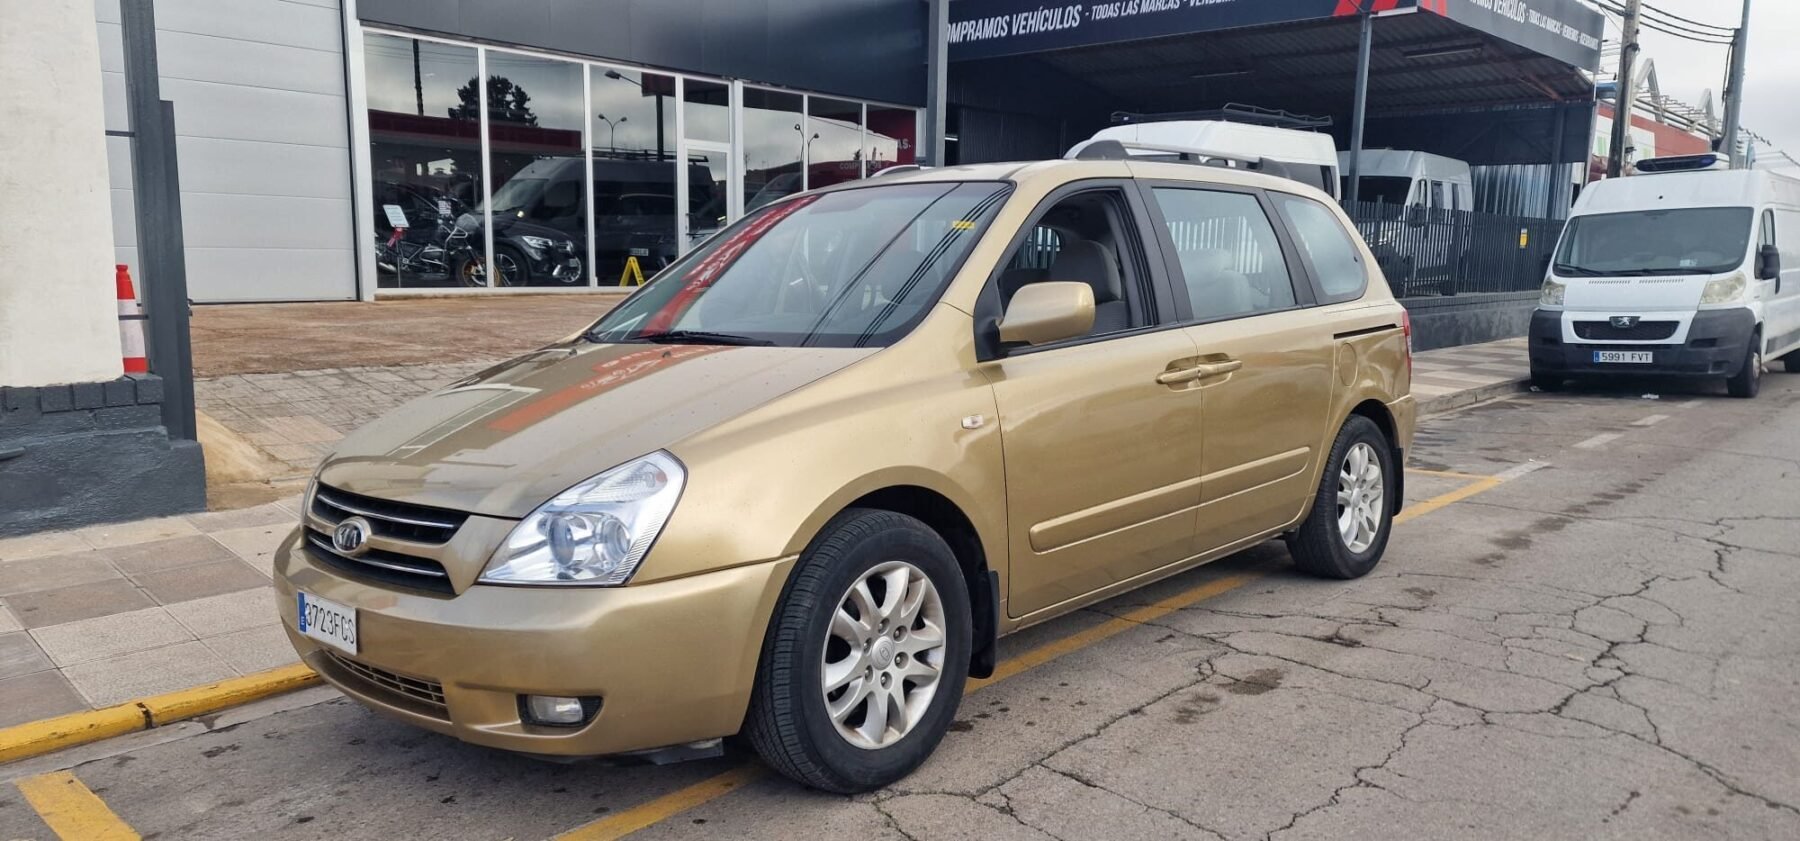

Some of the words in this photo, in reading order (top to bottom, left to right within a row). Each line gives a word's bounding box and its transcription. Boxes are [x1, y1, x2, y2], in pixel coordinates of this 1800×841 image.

[1012, 4, 1082, 36] VEHÍCULOS
[1091, 3, 1120, 21] TODAS
[1120, 0, 1139, 16] LAS
[1601, 352, 1626, 361] 5991
[1631, 352, 1651, 362] FVT
